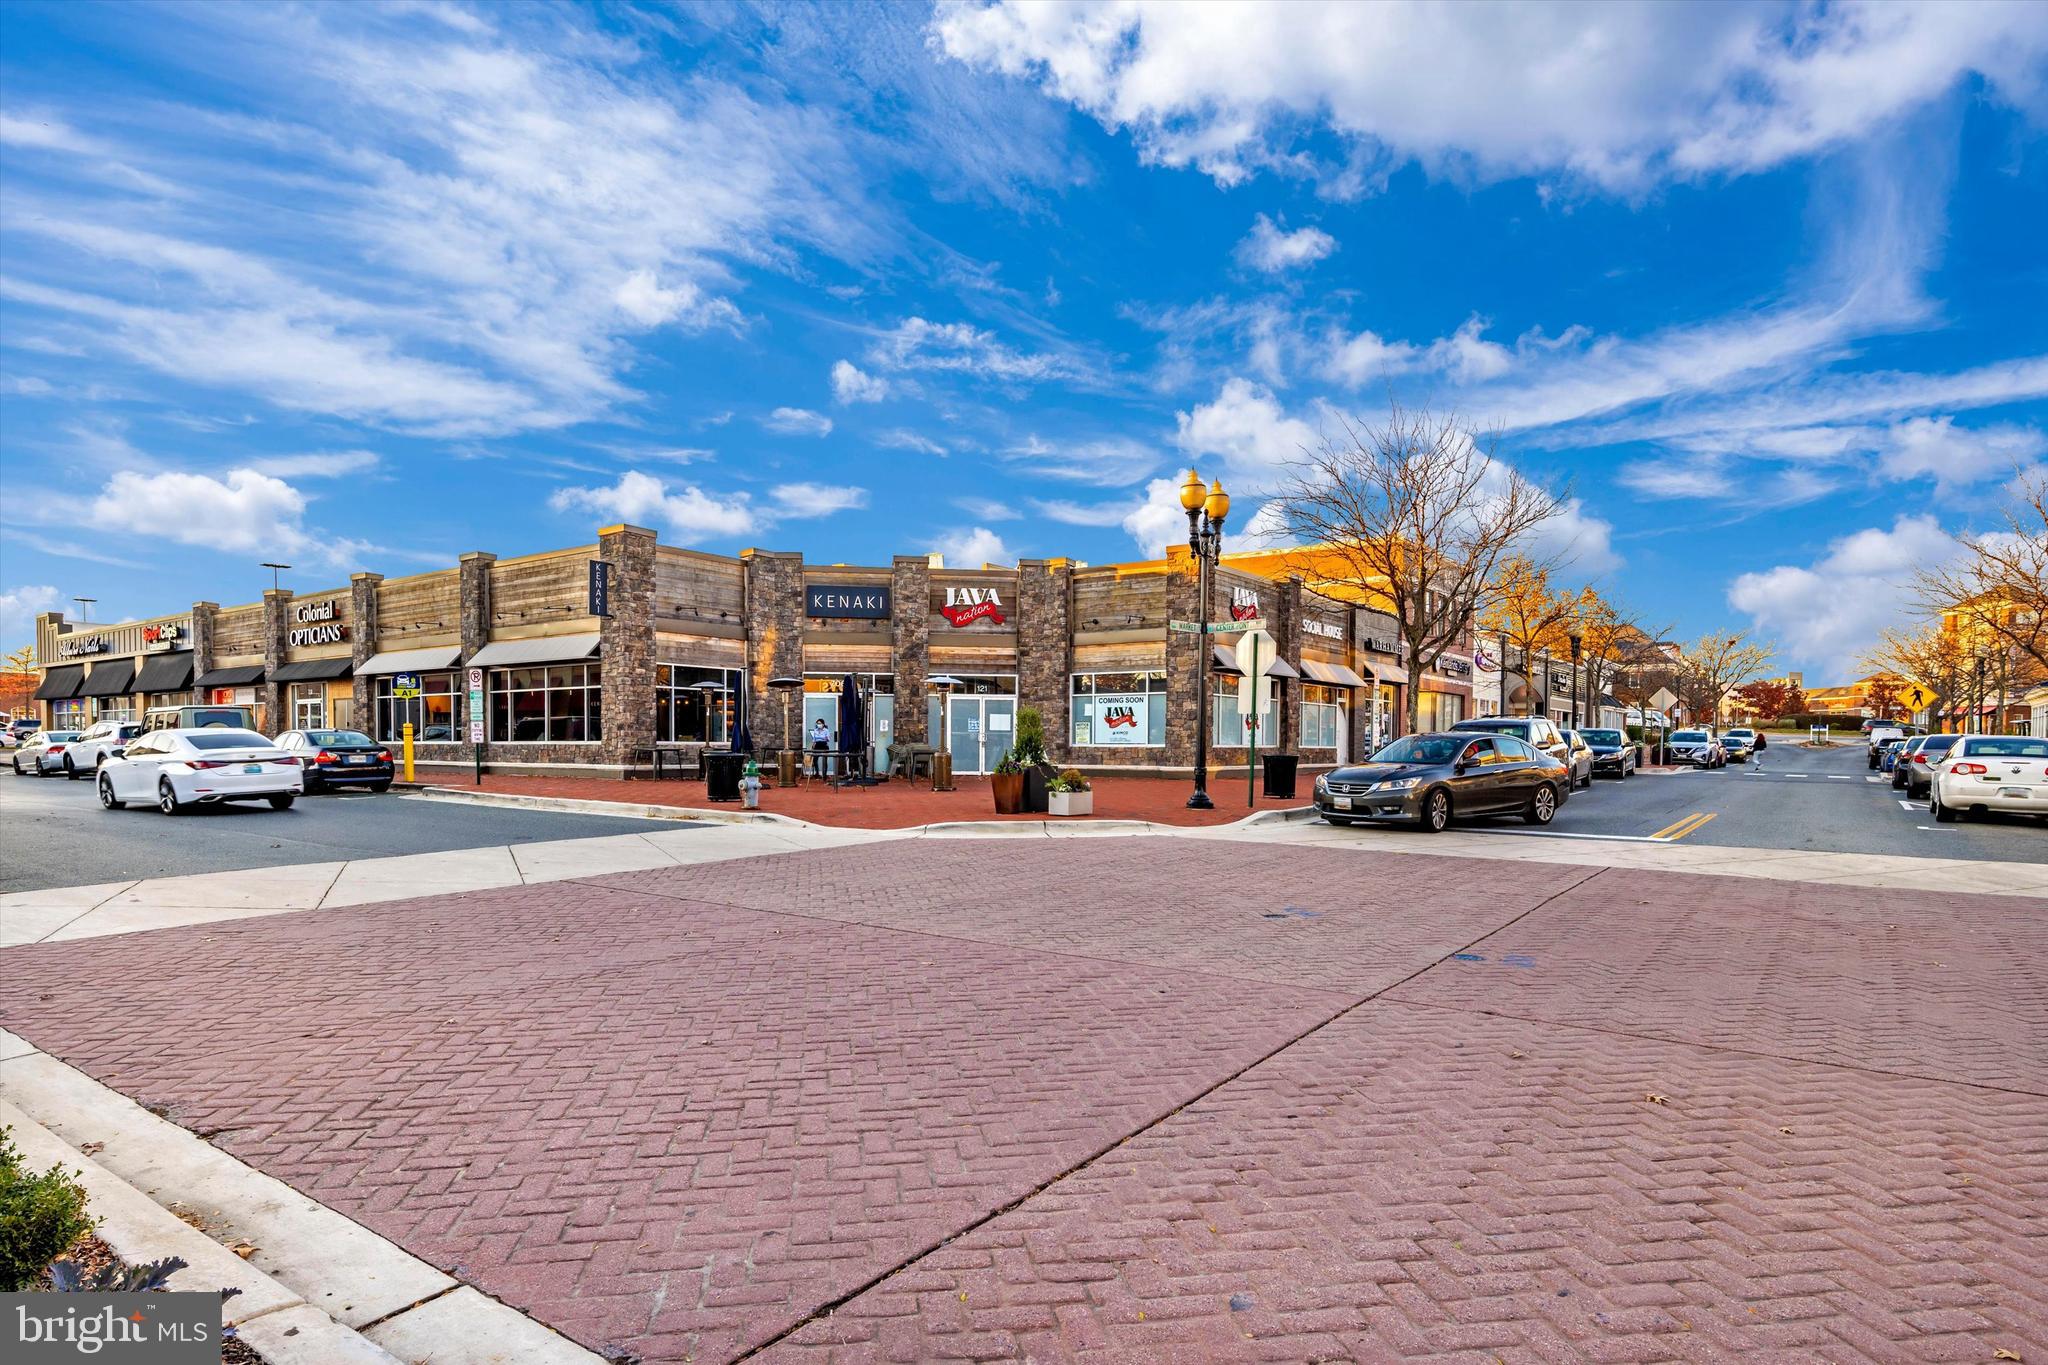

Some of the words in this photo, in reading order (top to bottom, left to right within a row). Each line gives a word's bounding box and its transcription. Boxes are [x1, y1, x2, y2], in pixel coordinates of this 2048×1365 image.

[814, 594, 883, 609] KENAKI
[945, 587, 1003, 606] JAVA
[296, 600, 333, 623] Colonial
[956, 604, 991, 623] nation
[289, 624, 341, 646] OPTICIANS
[1302, 618, 1324, 636] SOCIAL
[1324, 623, 1343, 640] HOUSE
[1105, 706, 1135, 717] JAVA
